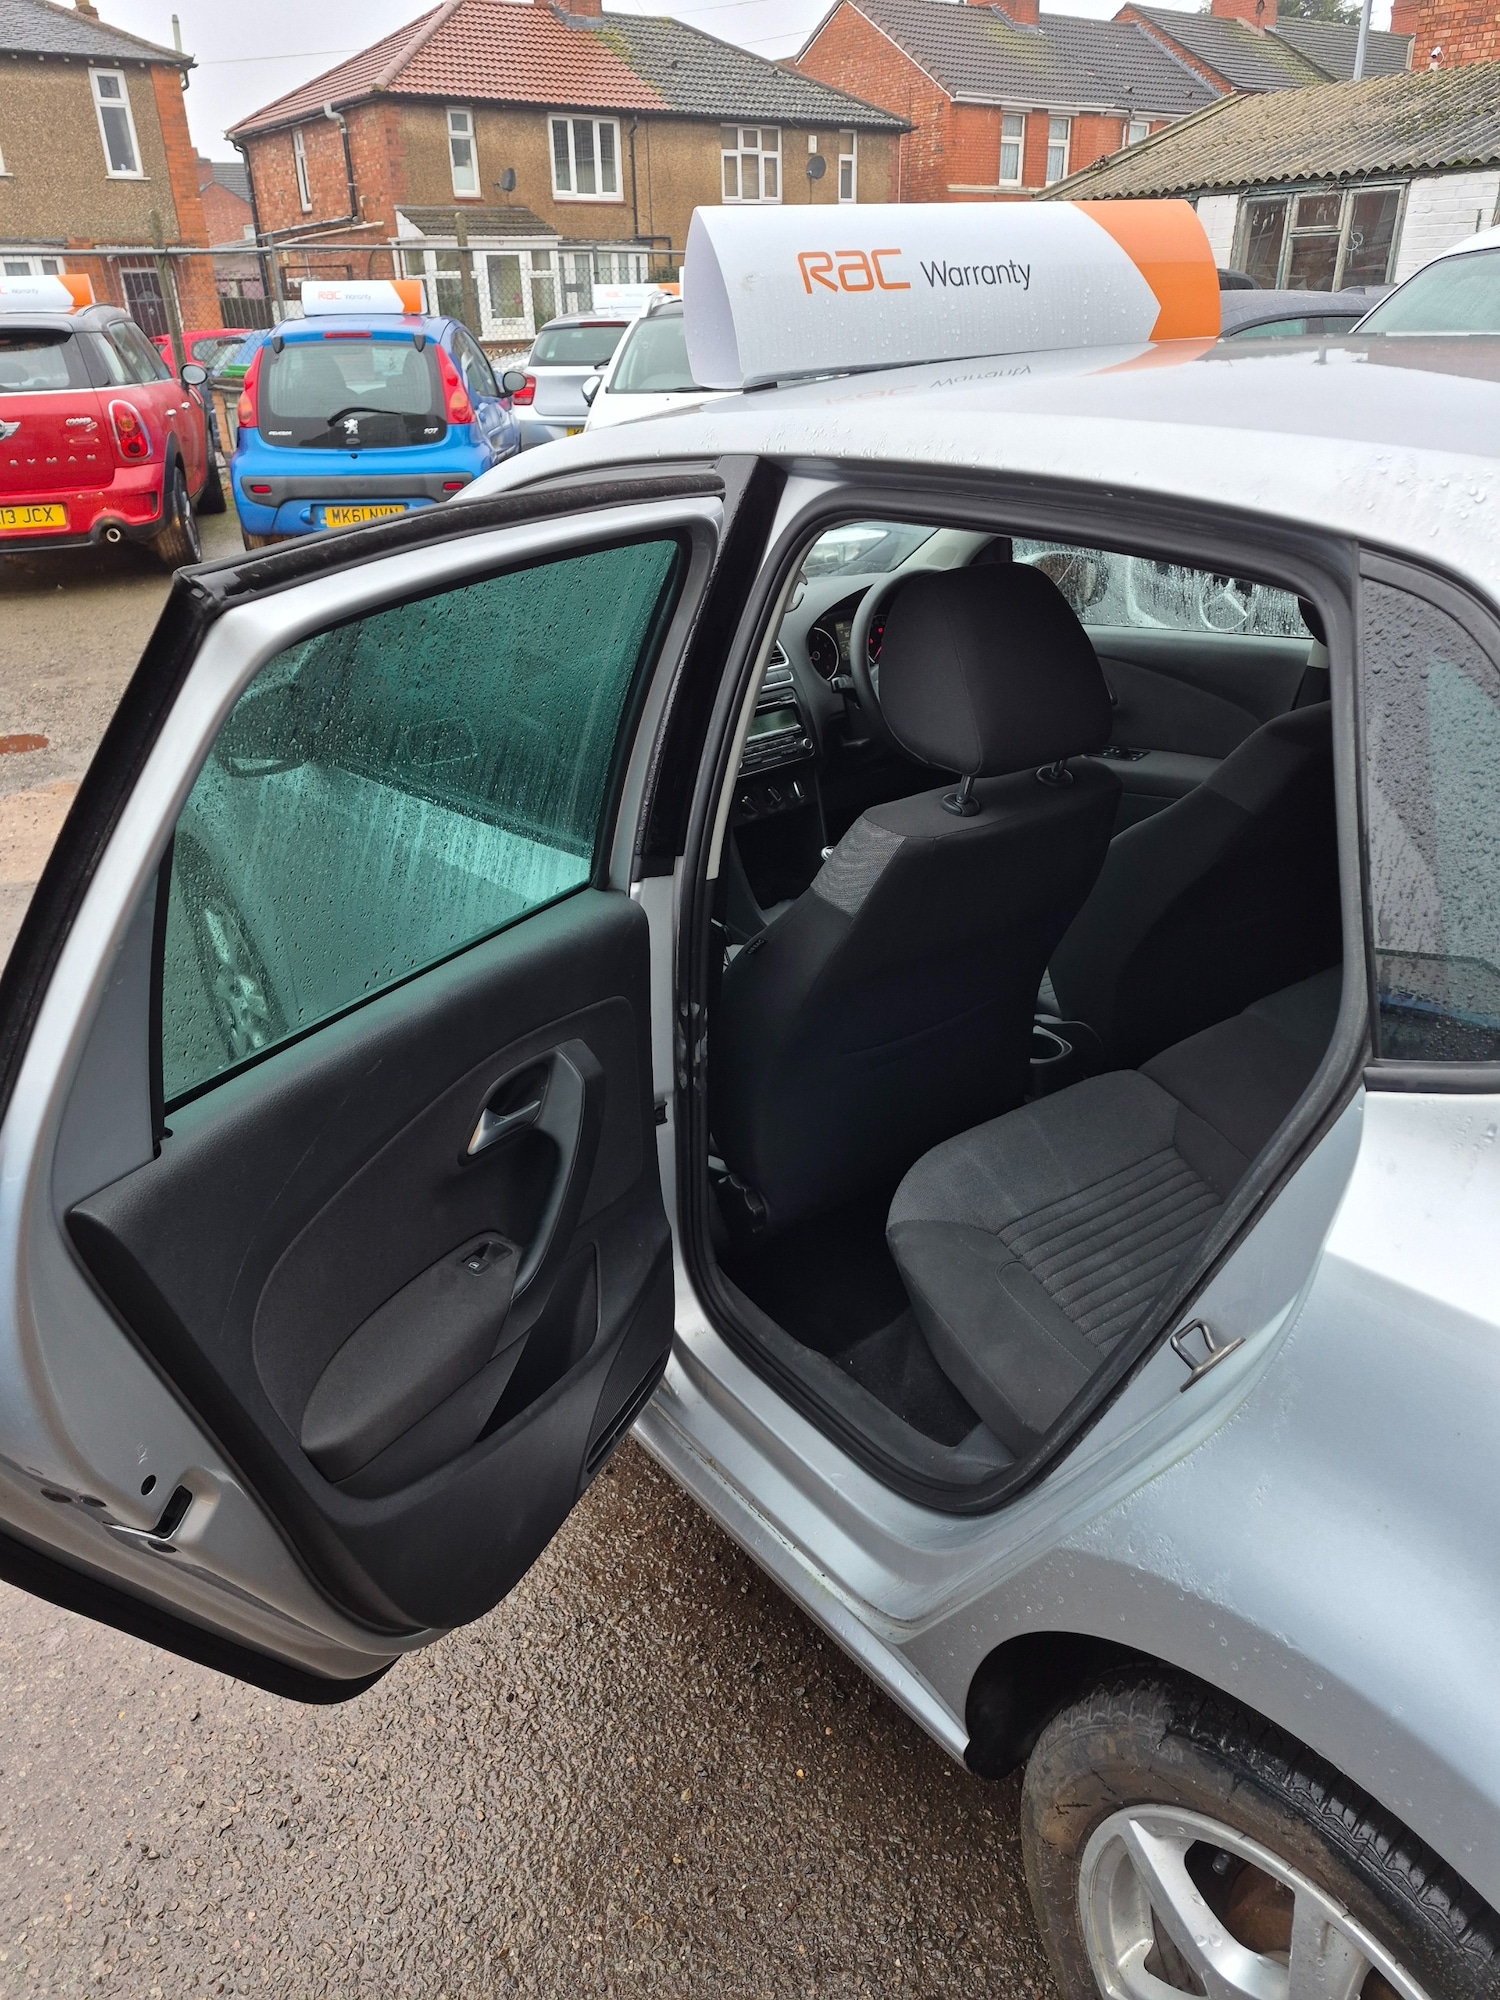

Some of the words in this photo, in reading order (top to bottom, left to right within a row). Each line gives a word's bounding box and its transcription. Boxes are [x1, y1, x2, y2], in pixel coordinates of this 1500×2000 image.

[919, 259, 1031, 291] Warranty
[423, 427, 439, 435] 107
[0, 509, 17, 525] 13
[22, 507, 55, 524] JCX
[331, 508, 366, 524] MK61
